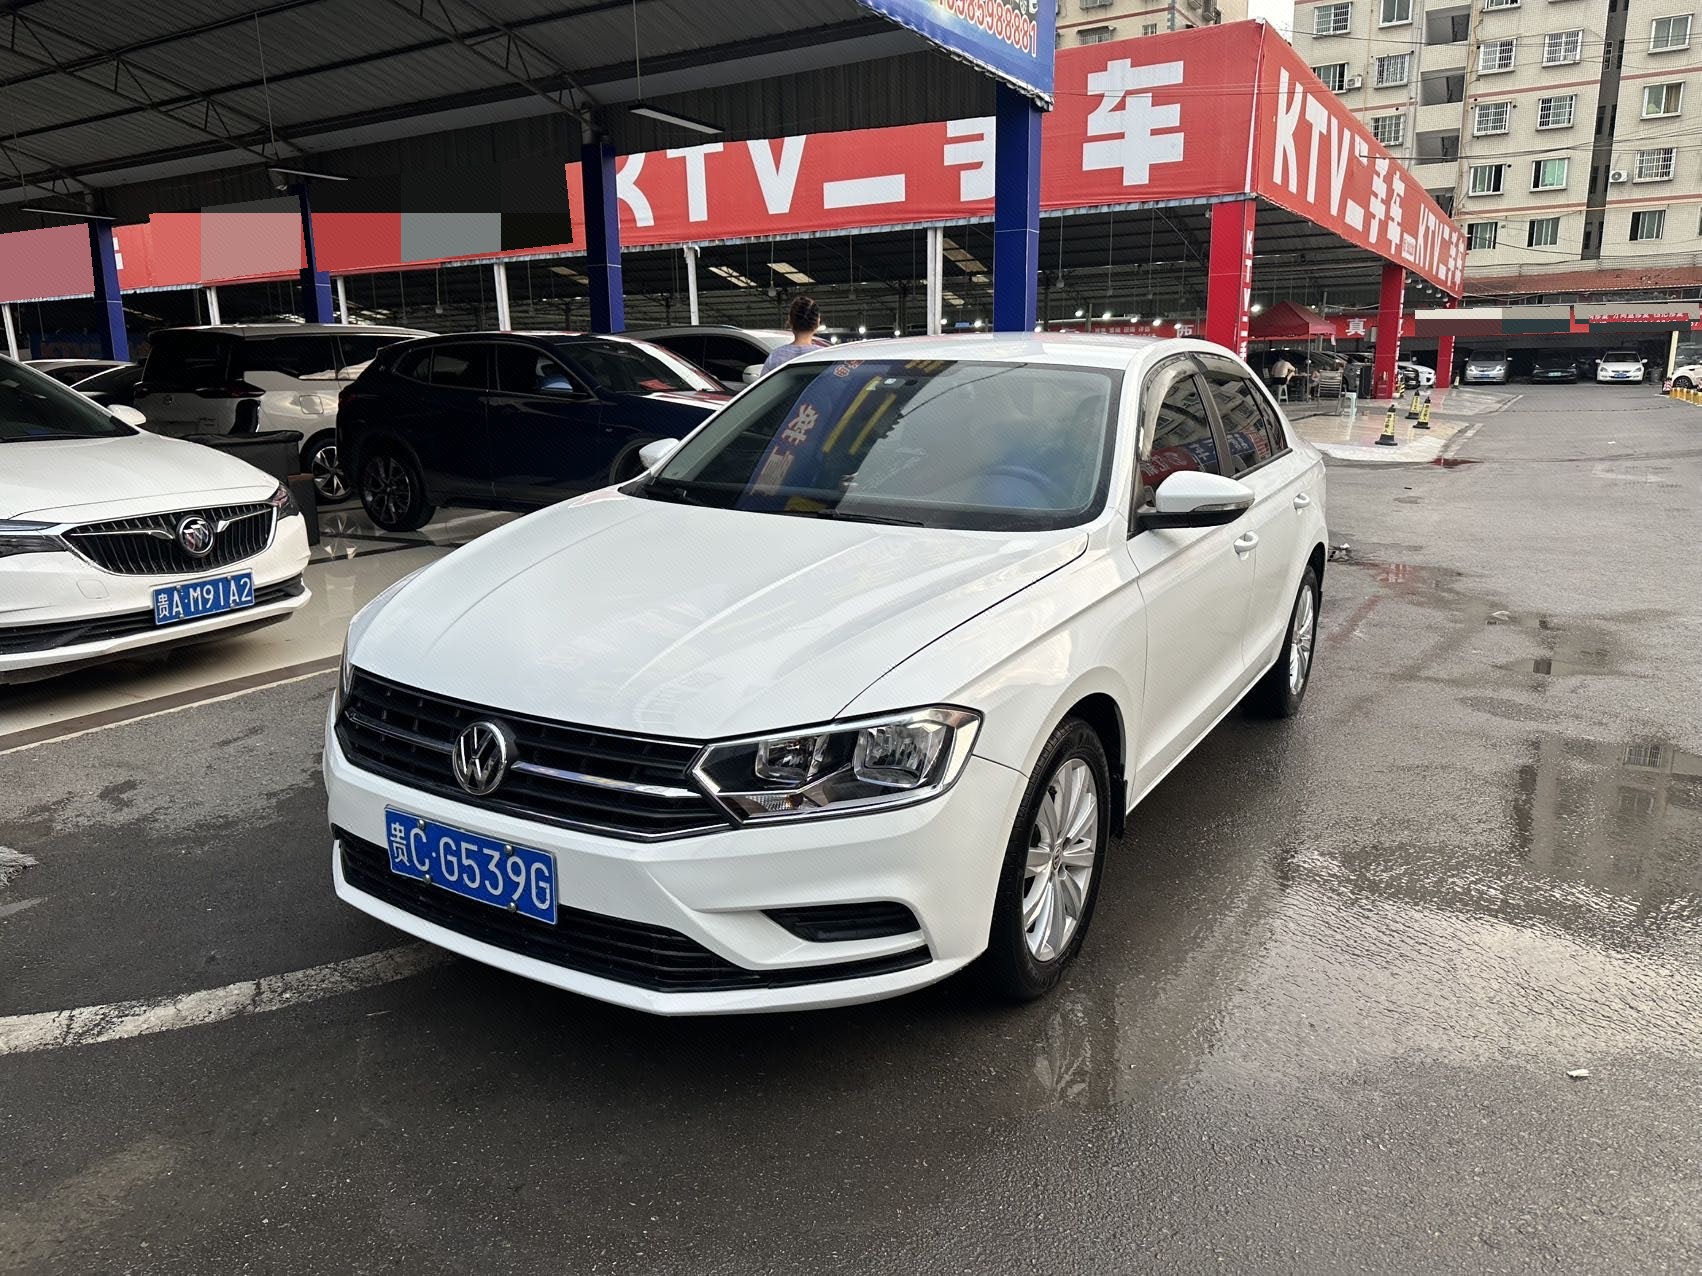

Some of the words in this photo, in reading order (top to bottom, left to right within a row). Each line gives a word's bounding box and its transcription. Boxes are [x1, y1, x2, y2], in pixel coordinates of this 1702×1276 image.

[1272, 66, 1406, 255] KTV二手车
[1345, 318, 1367, 336] 真
